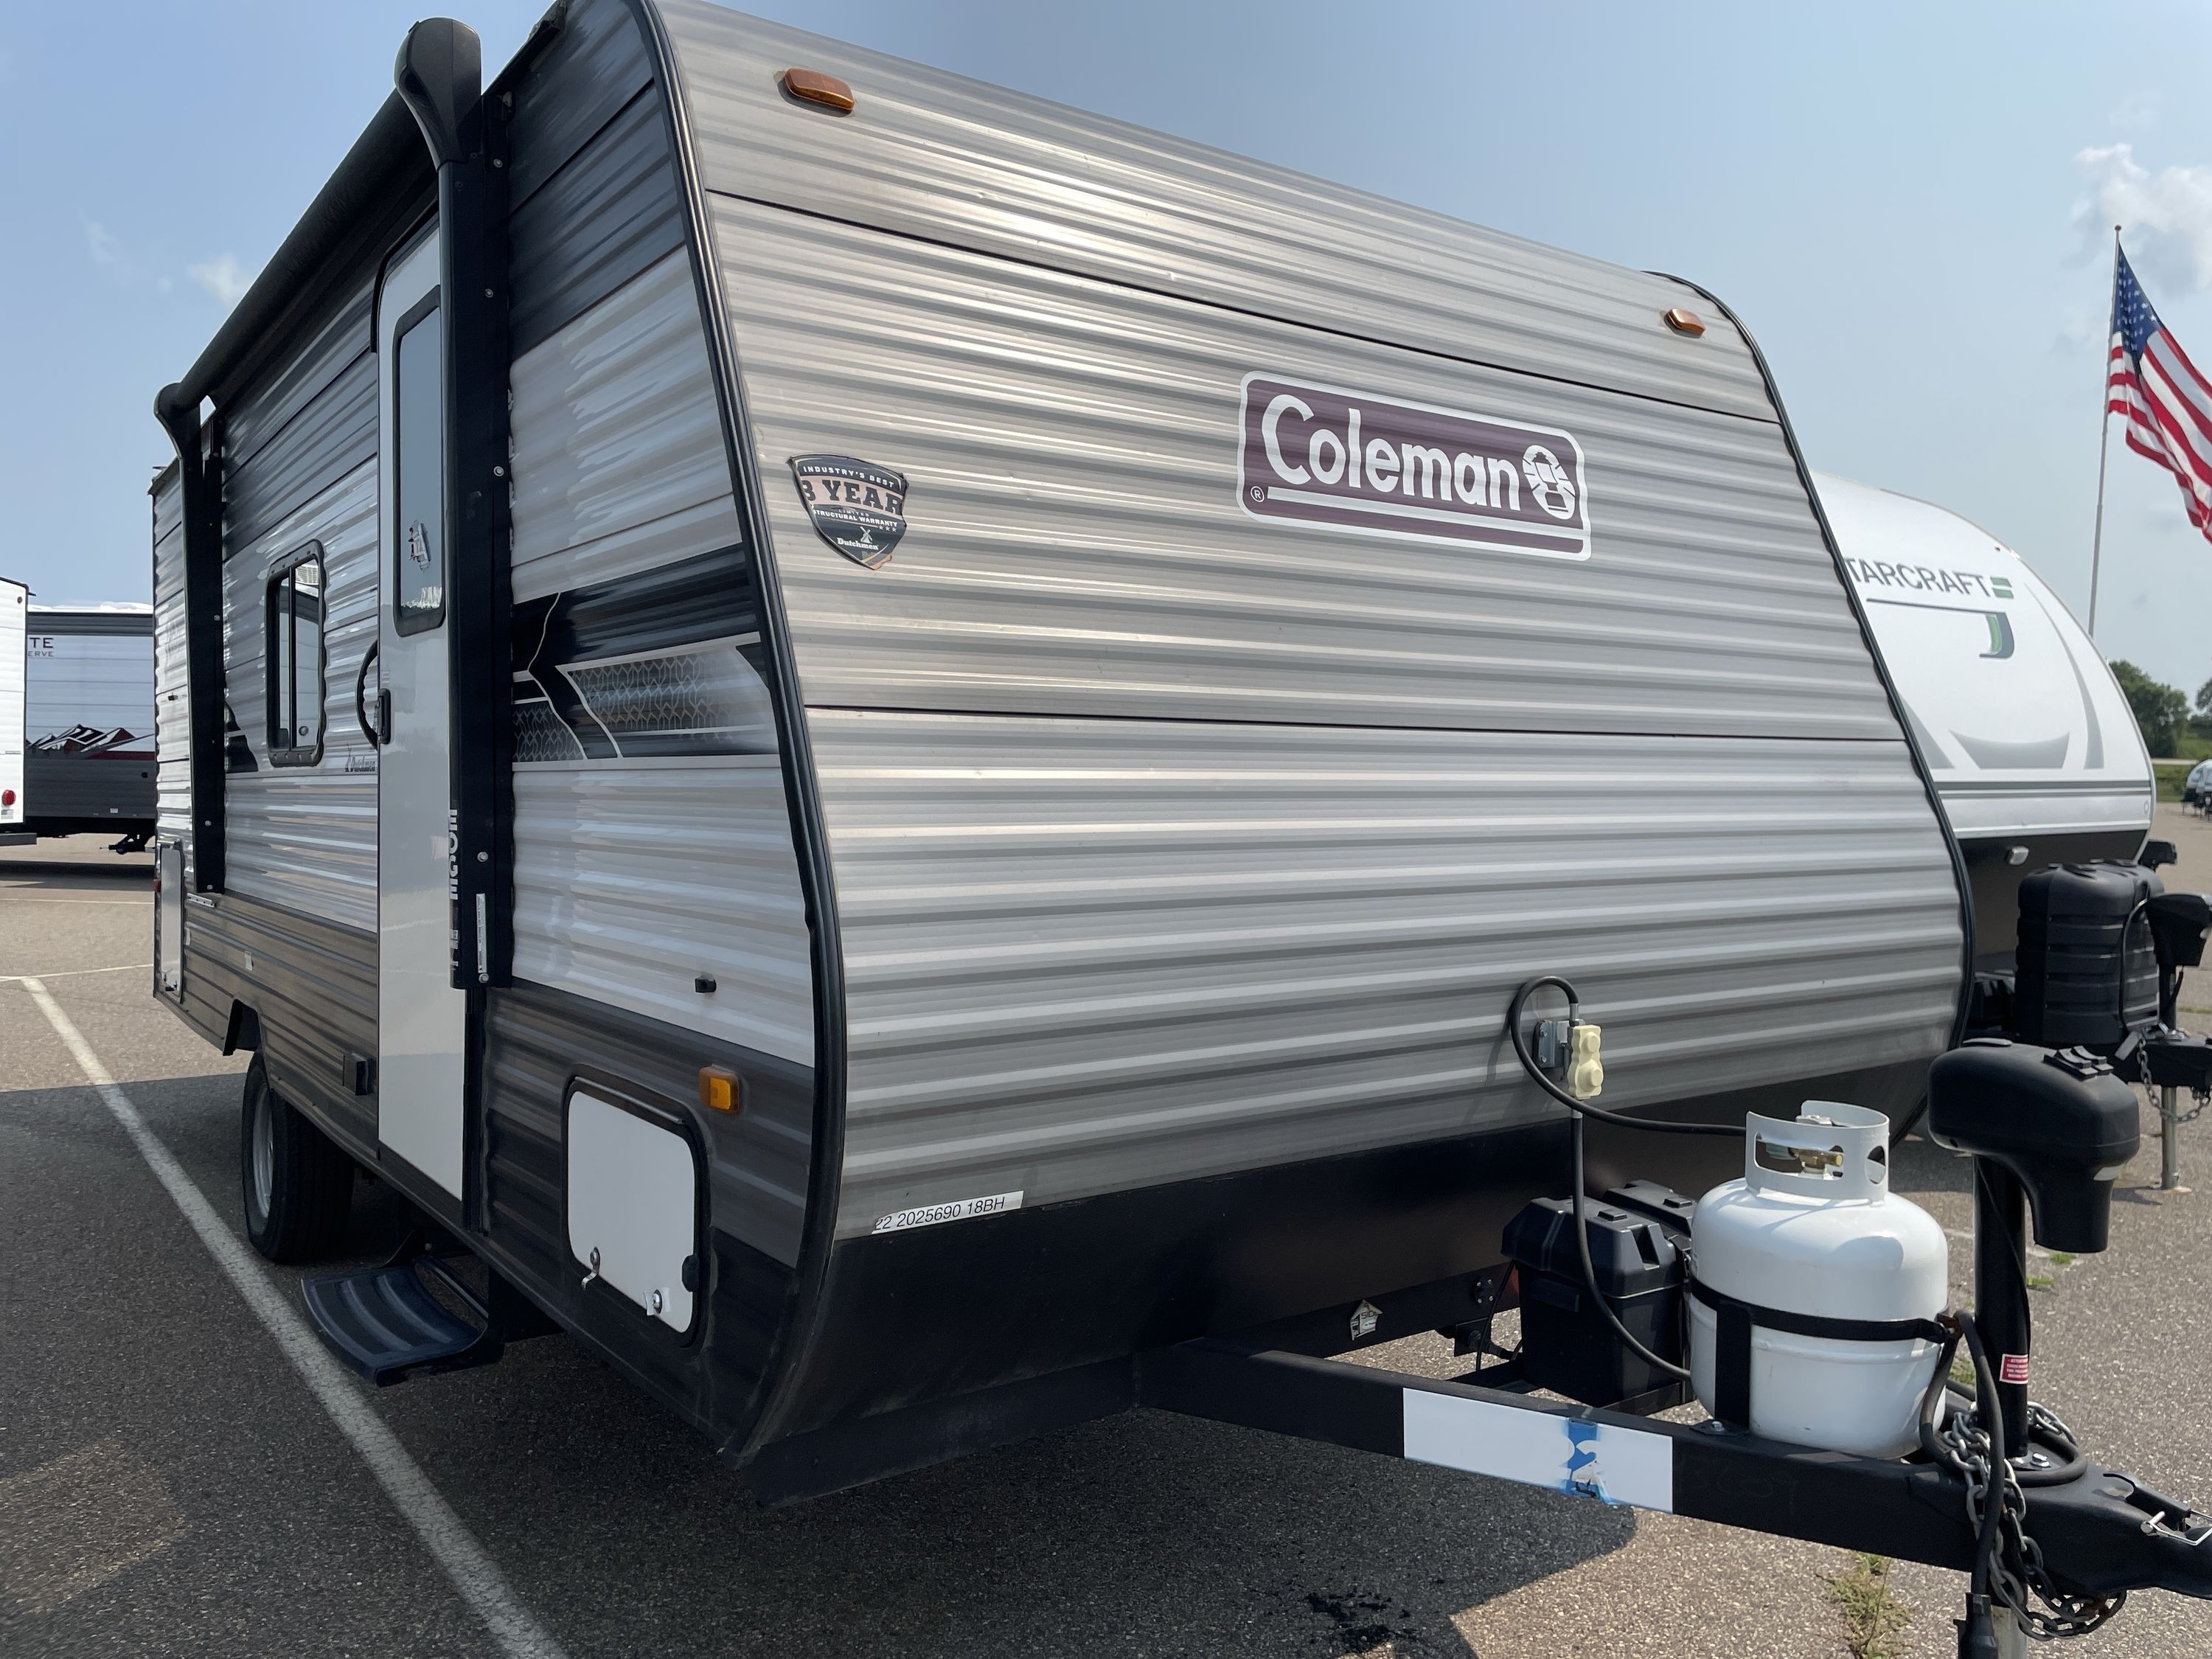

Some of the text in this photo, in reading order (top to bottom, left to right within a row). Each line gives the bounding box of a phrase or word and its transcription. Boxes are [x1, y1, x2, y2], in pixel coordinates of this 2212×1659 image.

[1262, 394, 1521, 511] Coleman
[803, 466, 894, 488] INDUSTRY'S BEST
[801, 479, 903, 515] 3 YEAR
[813, 509, 897, 528] STRUCTURAL WARRANTY
[837, 537, 879, 551] Dutchmen
[1844, 557, 1991, 597] TARCRAFT
[29, 637, 54, 648] TE
[897, 1204, 961, 1227] 2025690
[967, 1197, 1005, 1215] 18BH
